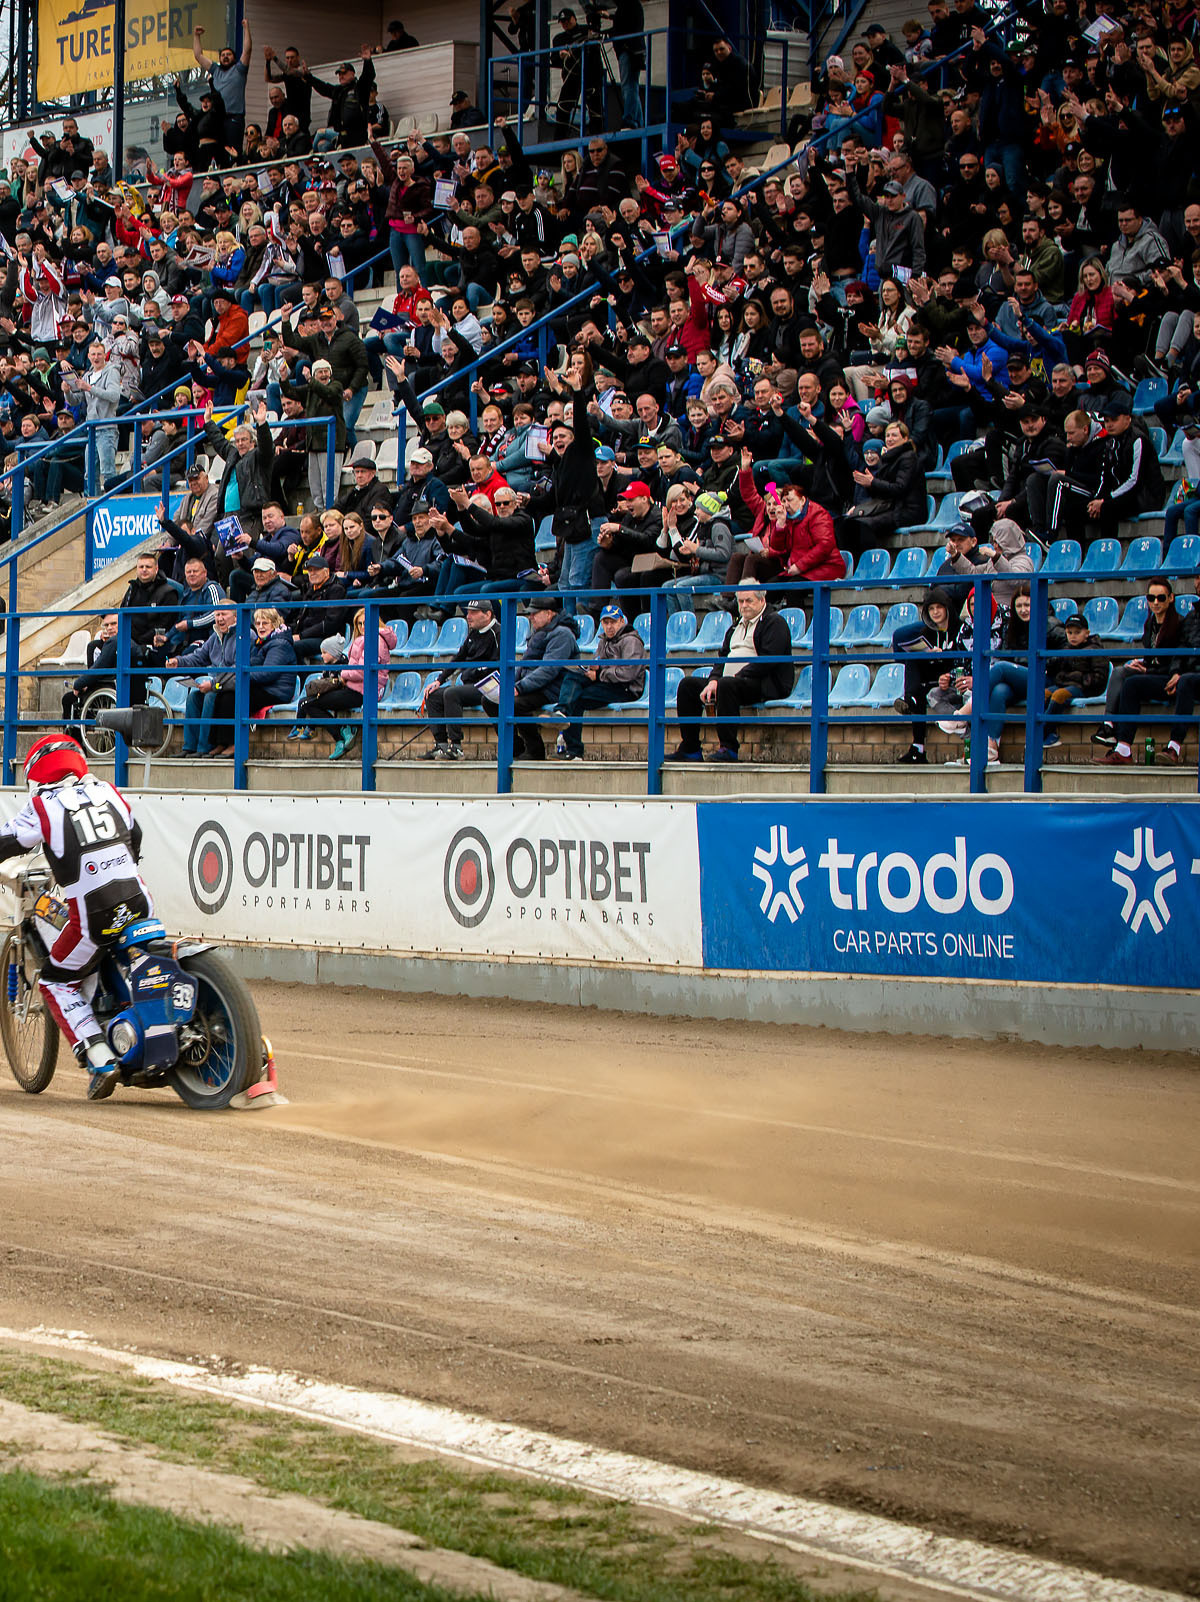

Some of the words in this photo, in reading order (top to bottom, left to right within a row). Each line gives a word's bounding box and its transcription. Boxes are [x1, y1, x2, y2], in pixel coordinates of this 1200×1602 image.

[56, 3, 198, 66] TURESPERT
[130, 55, 169, 71] AGENCY
[112, 514, 162, 537] STOKKE
[71, 804, 117, 845] 15
[243, 831, 371, 892] OPTIBET
[506, 837, 651, 903] OPTIBET
[818, 836, 1014, 916] trodo
[242, 894, 312, 911] SPORTA
[325, 895, 371, 913] BĀRS
[506, 905, 587, 923] SPORTA
[602, 906, 654, 927] BĀRS
[833, 929, 871, 953] CAR
[875, 930, 938, 956] PARTS
[943, 932, 1015, 959] ONLINE
